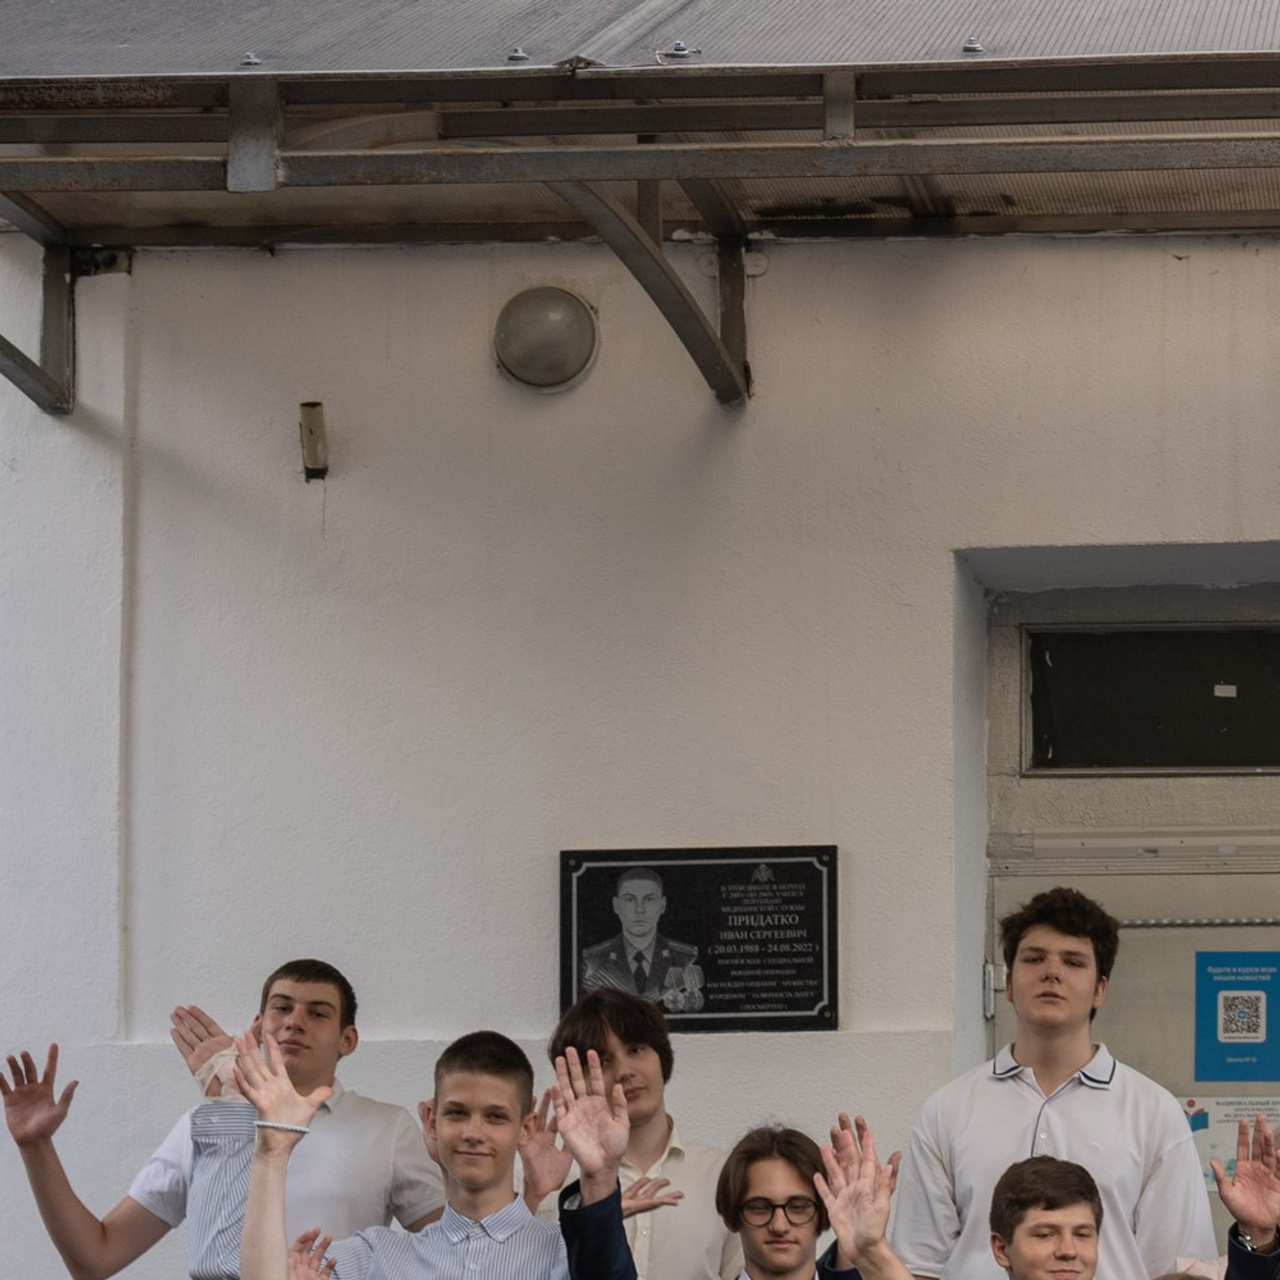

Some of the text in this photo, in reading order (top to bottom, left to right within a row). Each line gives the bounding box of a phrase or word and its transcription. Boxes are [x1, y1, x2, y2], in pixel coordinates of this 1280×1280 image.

[728, 914, 799, 926] ПРИДАТКО
[719, 929, 807, 940] ИВАН СЕРГЕЕВИЧ
